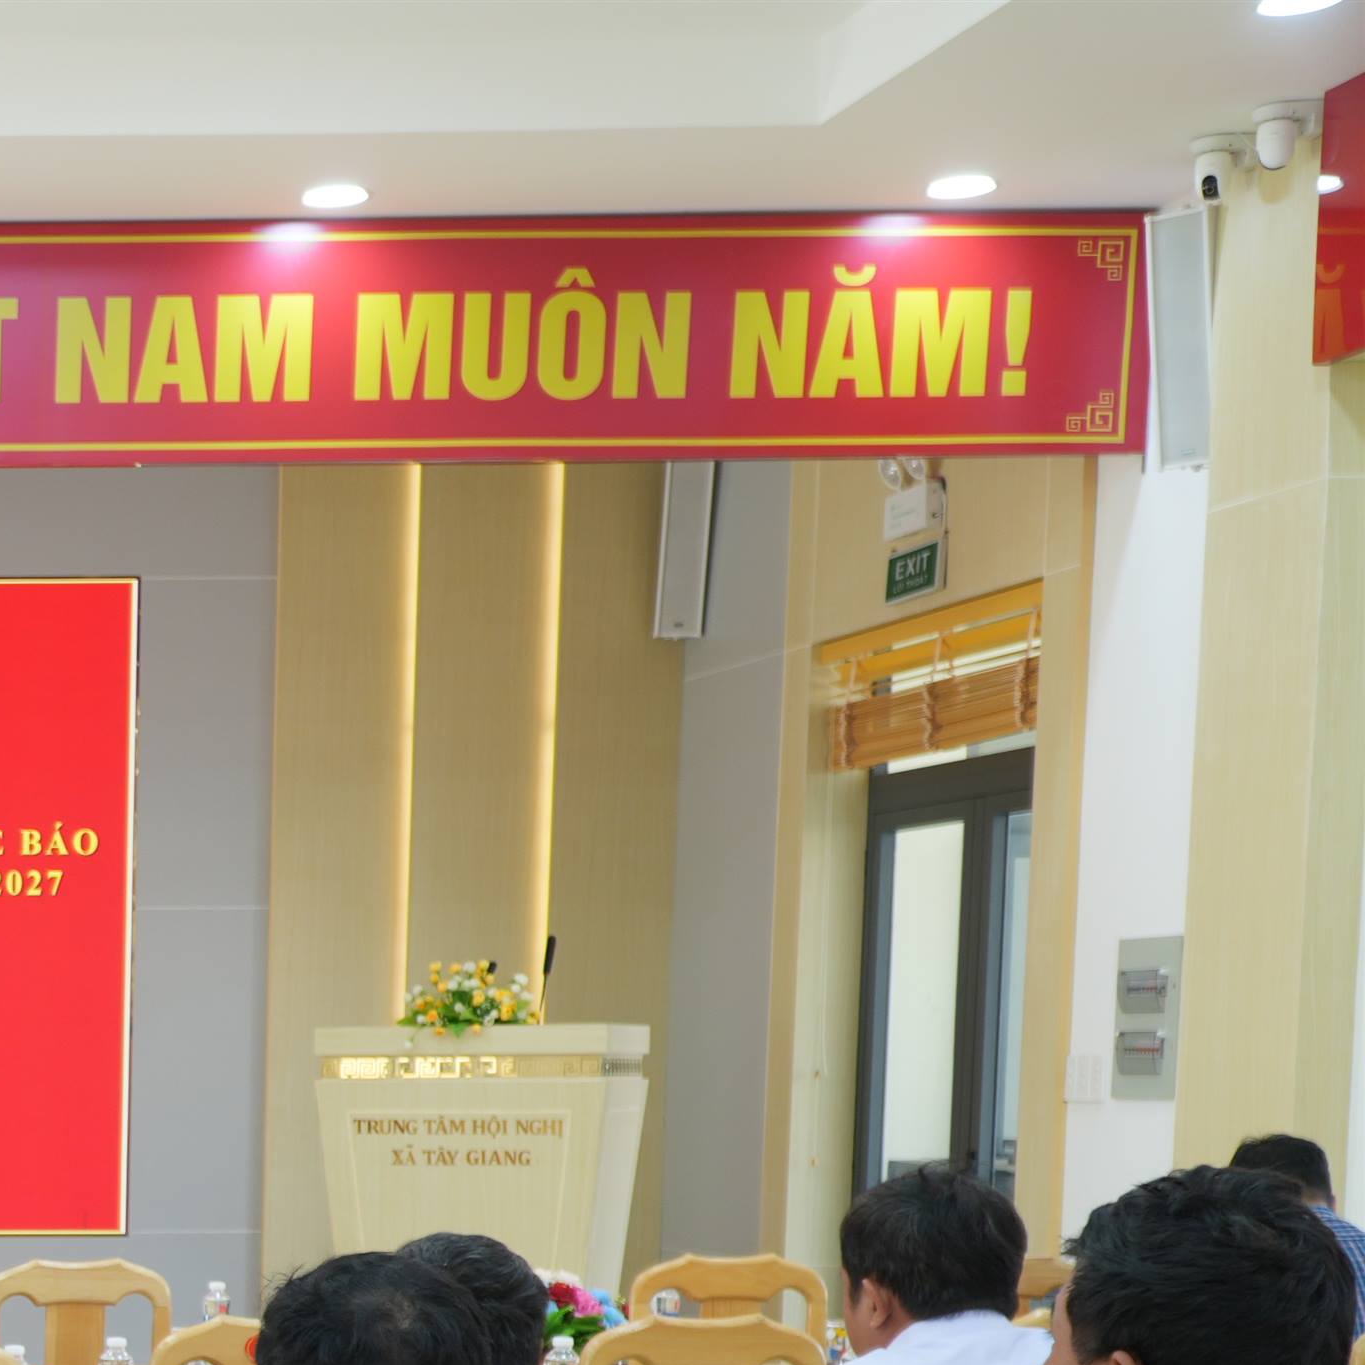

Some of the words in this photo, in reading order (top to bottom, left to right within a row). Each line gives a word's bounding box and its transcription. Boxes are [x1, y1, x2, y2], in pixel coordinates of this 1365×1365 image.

[53, 292, 315, 404] NAM
[352, 266, 693, 401] MUÔN
[728, 262, 1033, 399] NĂM!
[895, 552, 931, 581] EXIT
[19, 821, 100, 857] BÁO
[353, 1118, 418, 1136] TRUNG
[423, 1115, 466, 1136] TÂM
[472, 1115, 509, 1139] HỘI
[515, 1118, 564, 1139] NGHỊ
[391, 1144, 417, 1166] XÃ
[423, 1148, 458, 1166] TÂY
[466, 1150, 531, 1167] GIANG
